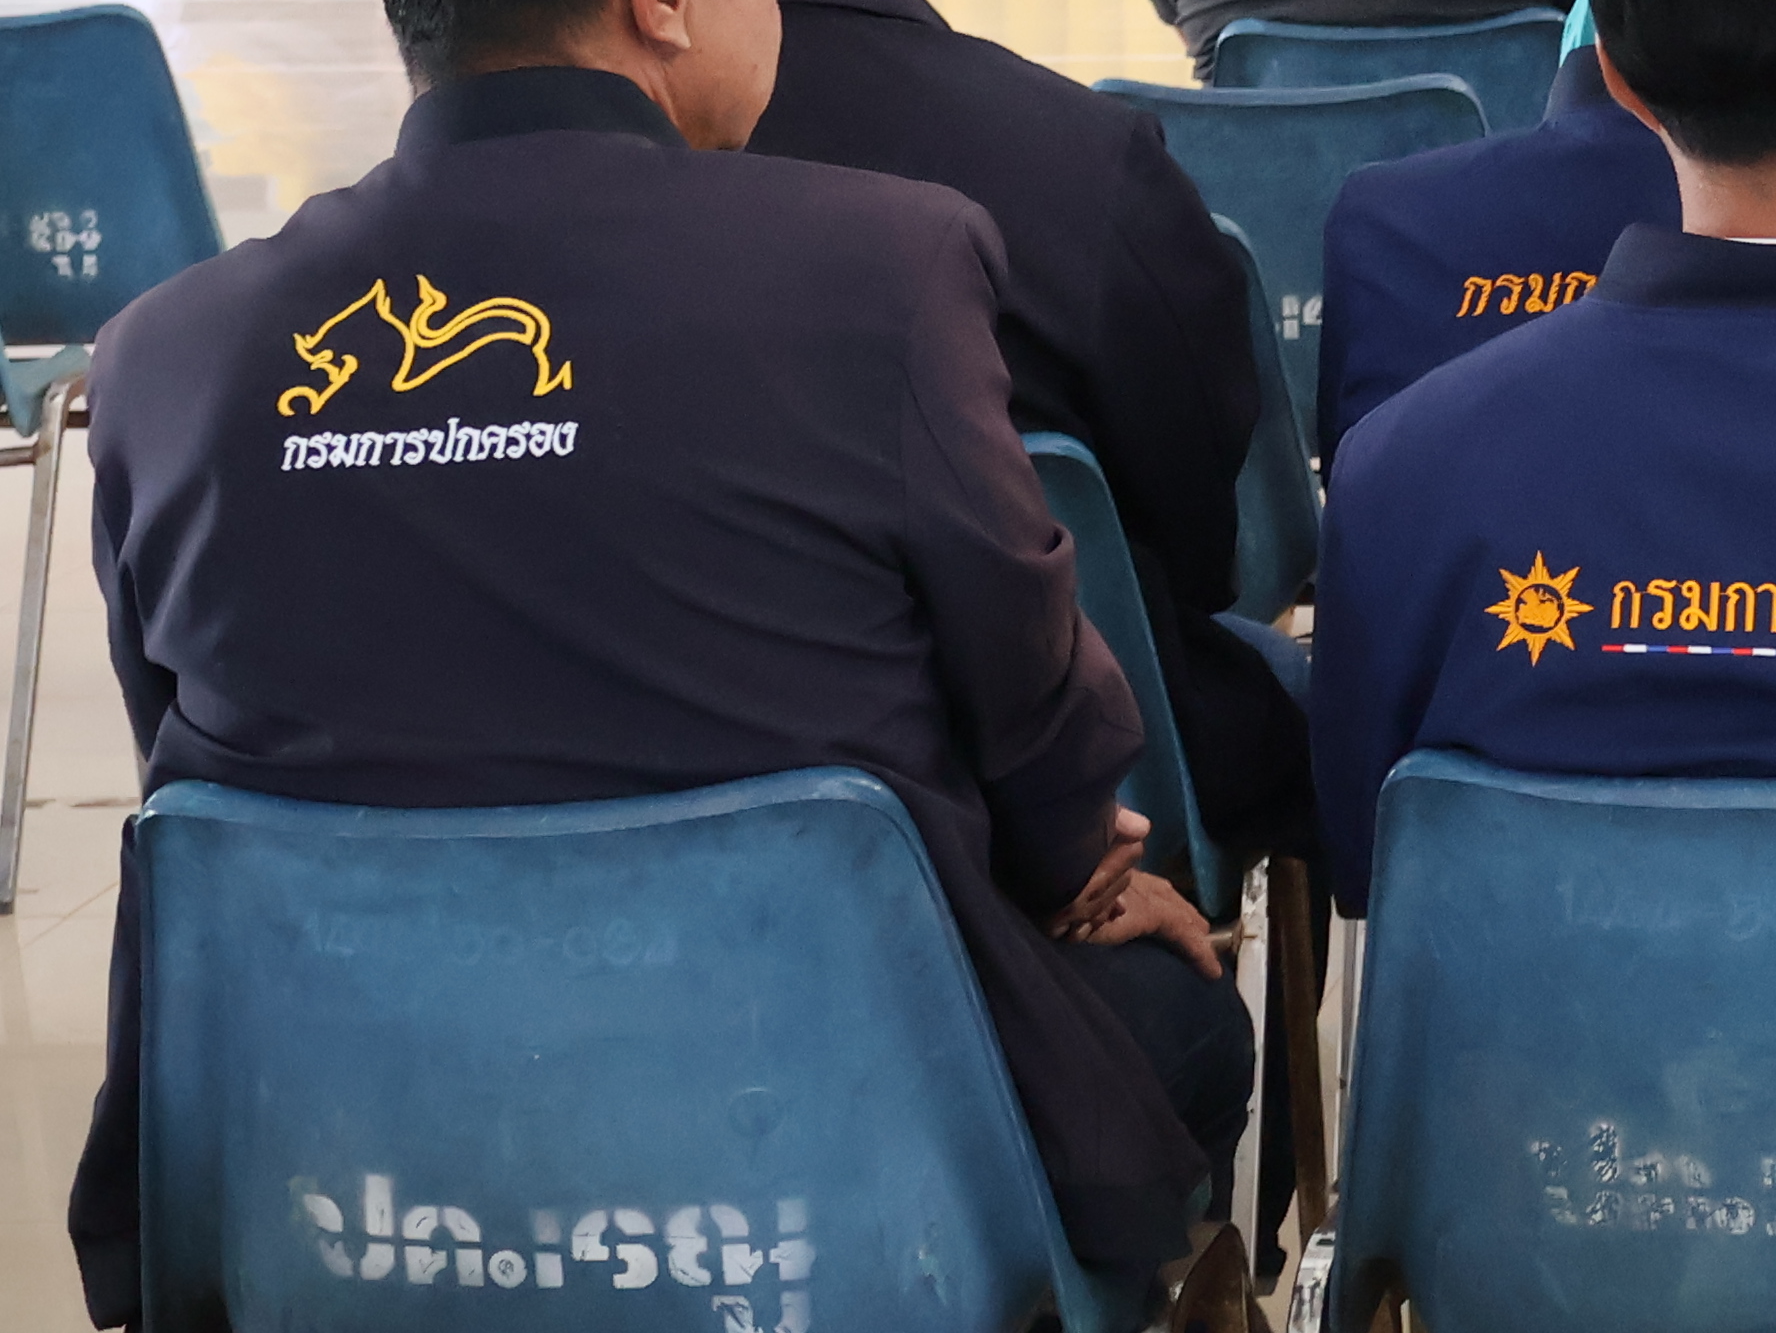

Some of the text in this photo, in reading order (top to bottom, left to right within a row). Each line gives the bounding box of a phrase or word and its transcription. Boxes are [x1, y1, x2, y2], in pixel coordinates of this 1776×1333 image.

[281, 418, 579, 472] กรมการปกครอง
